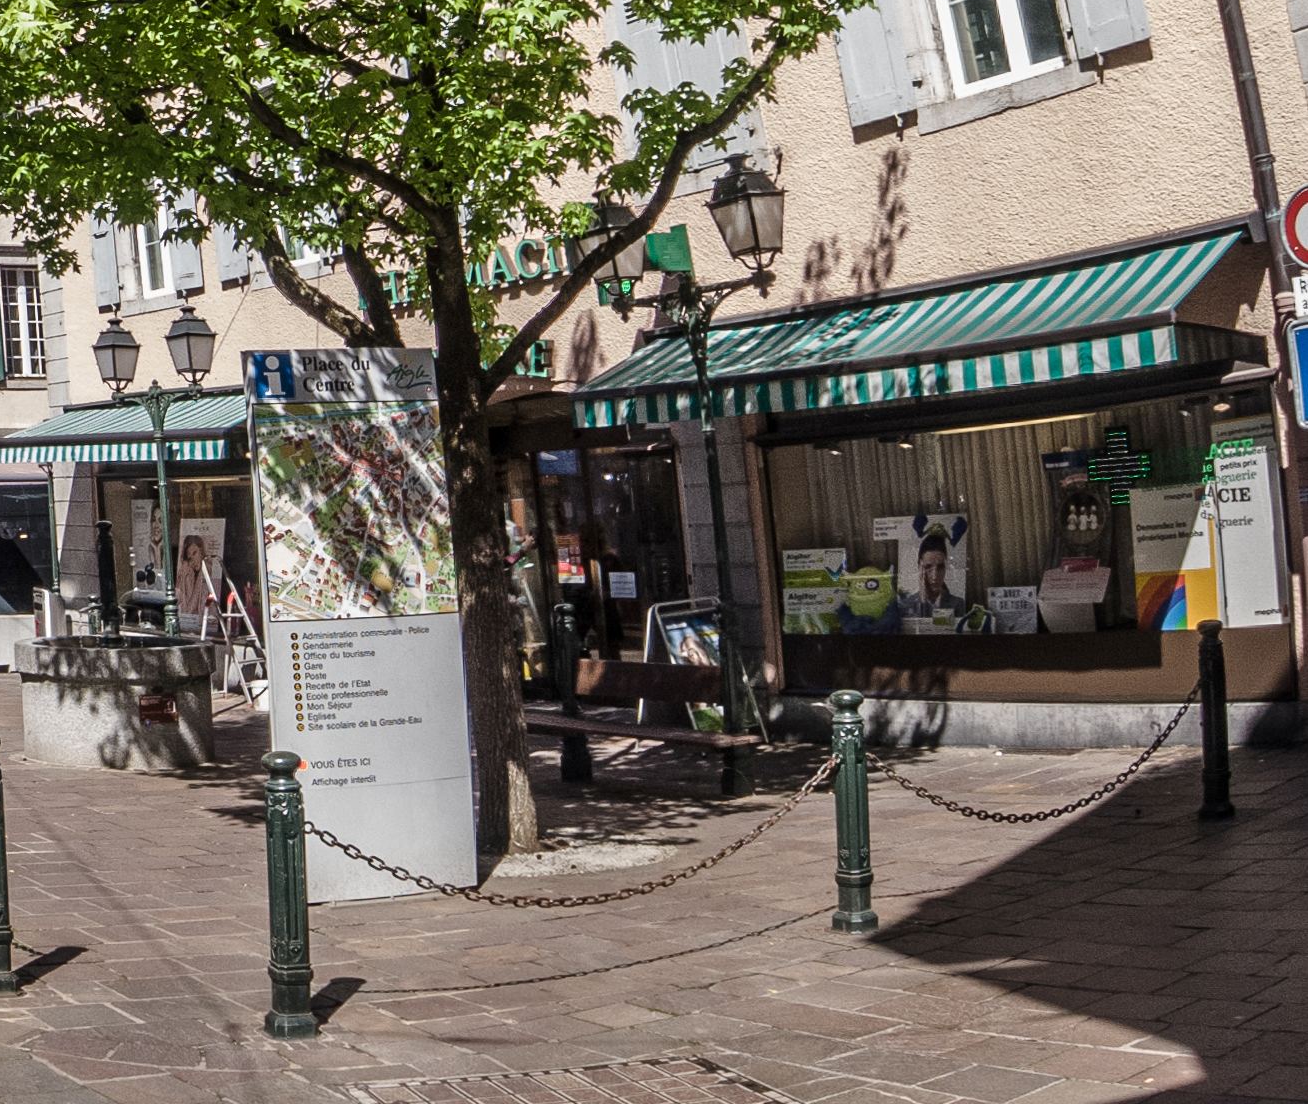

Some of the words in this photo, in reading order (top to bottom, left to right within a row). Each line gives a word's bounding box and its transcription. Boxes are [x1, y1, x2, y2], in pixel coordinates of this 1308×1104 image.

[303, 356, 344, 372] Place
[351, 358, 371, 371] du
[303, 377, 355, 393] Centre
[1242, 459, 1257, 468] prix
[302, 631, 358, 640] Administration
[361, 628, 402, 637] communale
[409, 627, 430, 635] Police
[303, 641, 353, 650] Gendarmerie
[303, 652, 327, 660] Office
[330, 651, 340, 659] du
[343, 649, 375, 659] tourisme
[304, 662, 323, 670] Gare
[305, 672, 327, 680] Poste
[306, 682, 335, 691] Recette
[339, 681, 349, 689] de
[352, 680, 371, 688] l'Etat
[306, 692, 328, 701] Ecole
[331, 688, 389, 701] professionnelle
[307, 702, 325, 711] Mon
[327, 701, 353, 711] Séjour
[307, 712, 336, 723] Eglises
[308, 722, 324, 731] Site
[327, 721, 356, 731] scolaire
[358, 719, 368, 728] de
[370, 719, 377, 727] la
[379, 716, 422, 726] Grande-Eau
[311, 760, 335, 769] VOUS
[337, 757, 358, 768] ÊTES
[359, 758, 371, 766] ICI
[311, 776, 348, 786] Affichage
[350, 775, 377, 784] interdit
